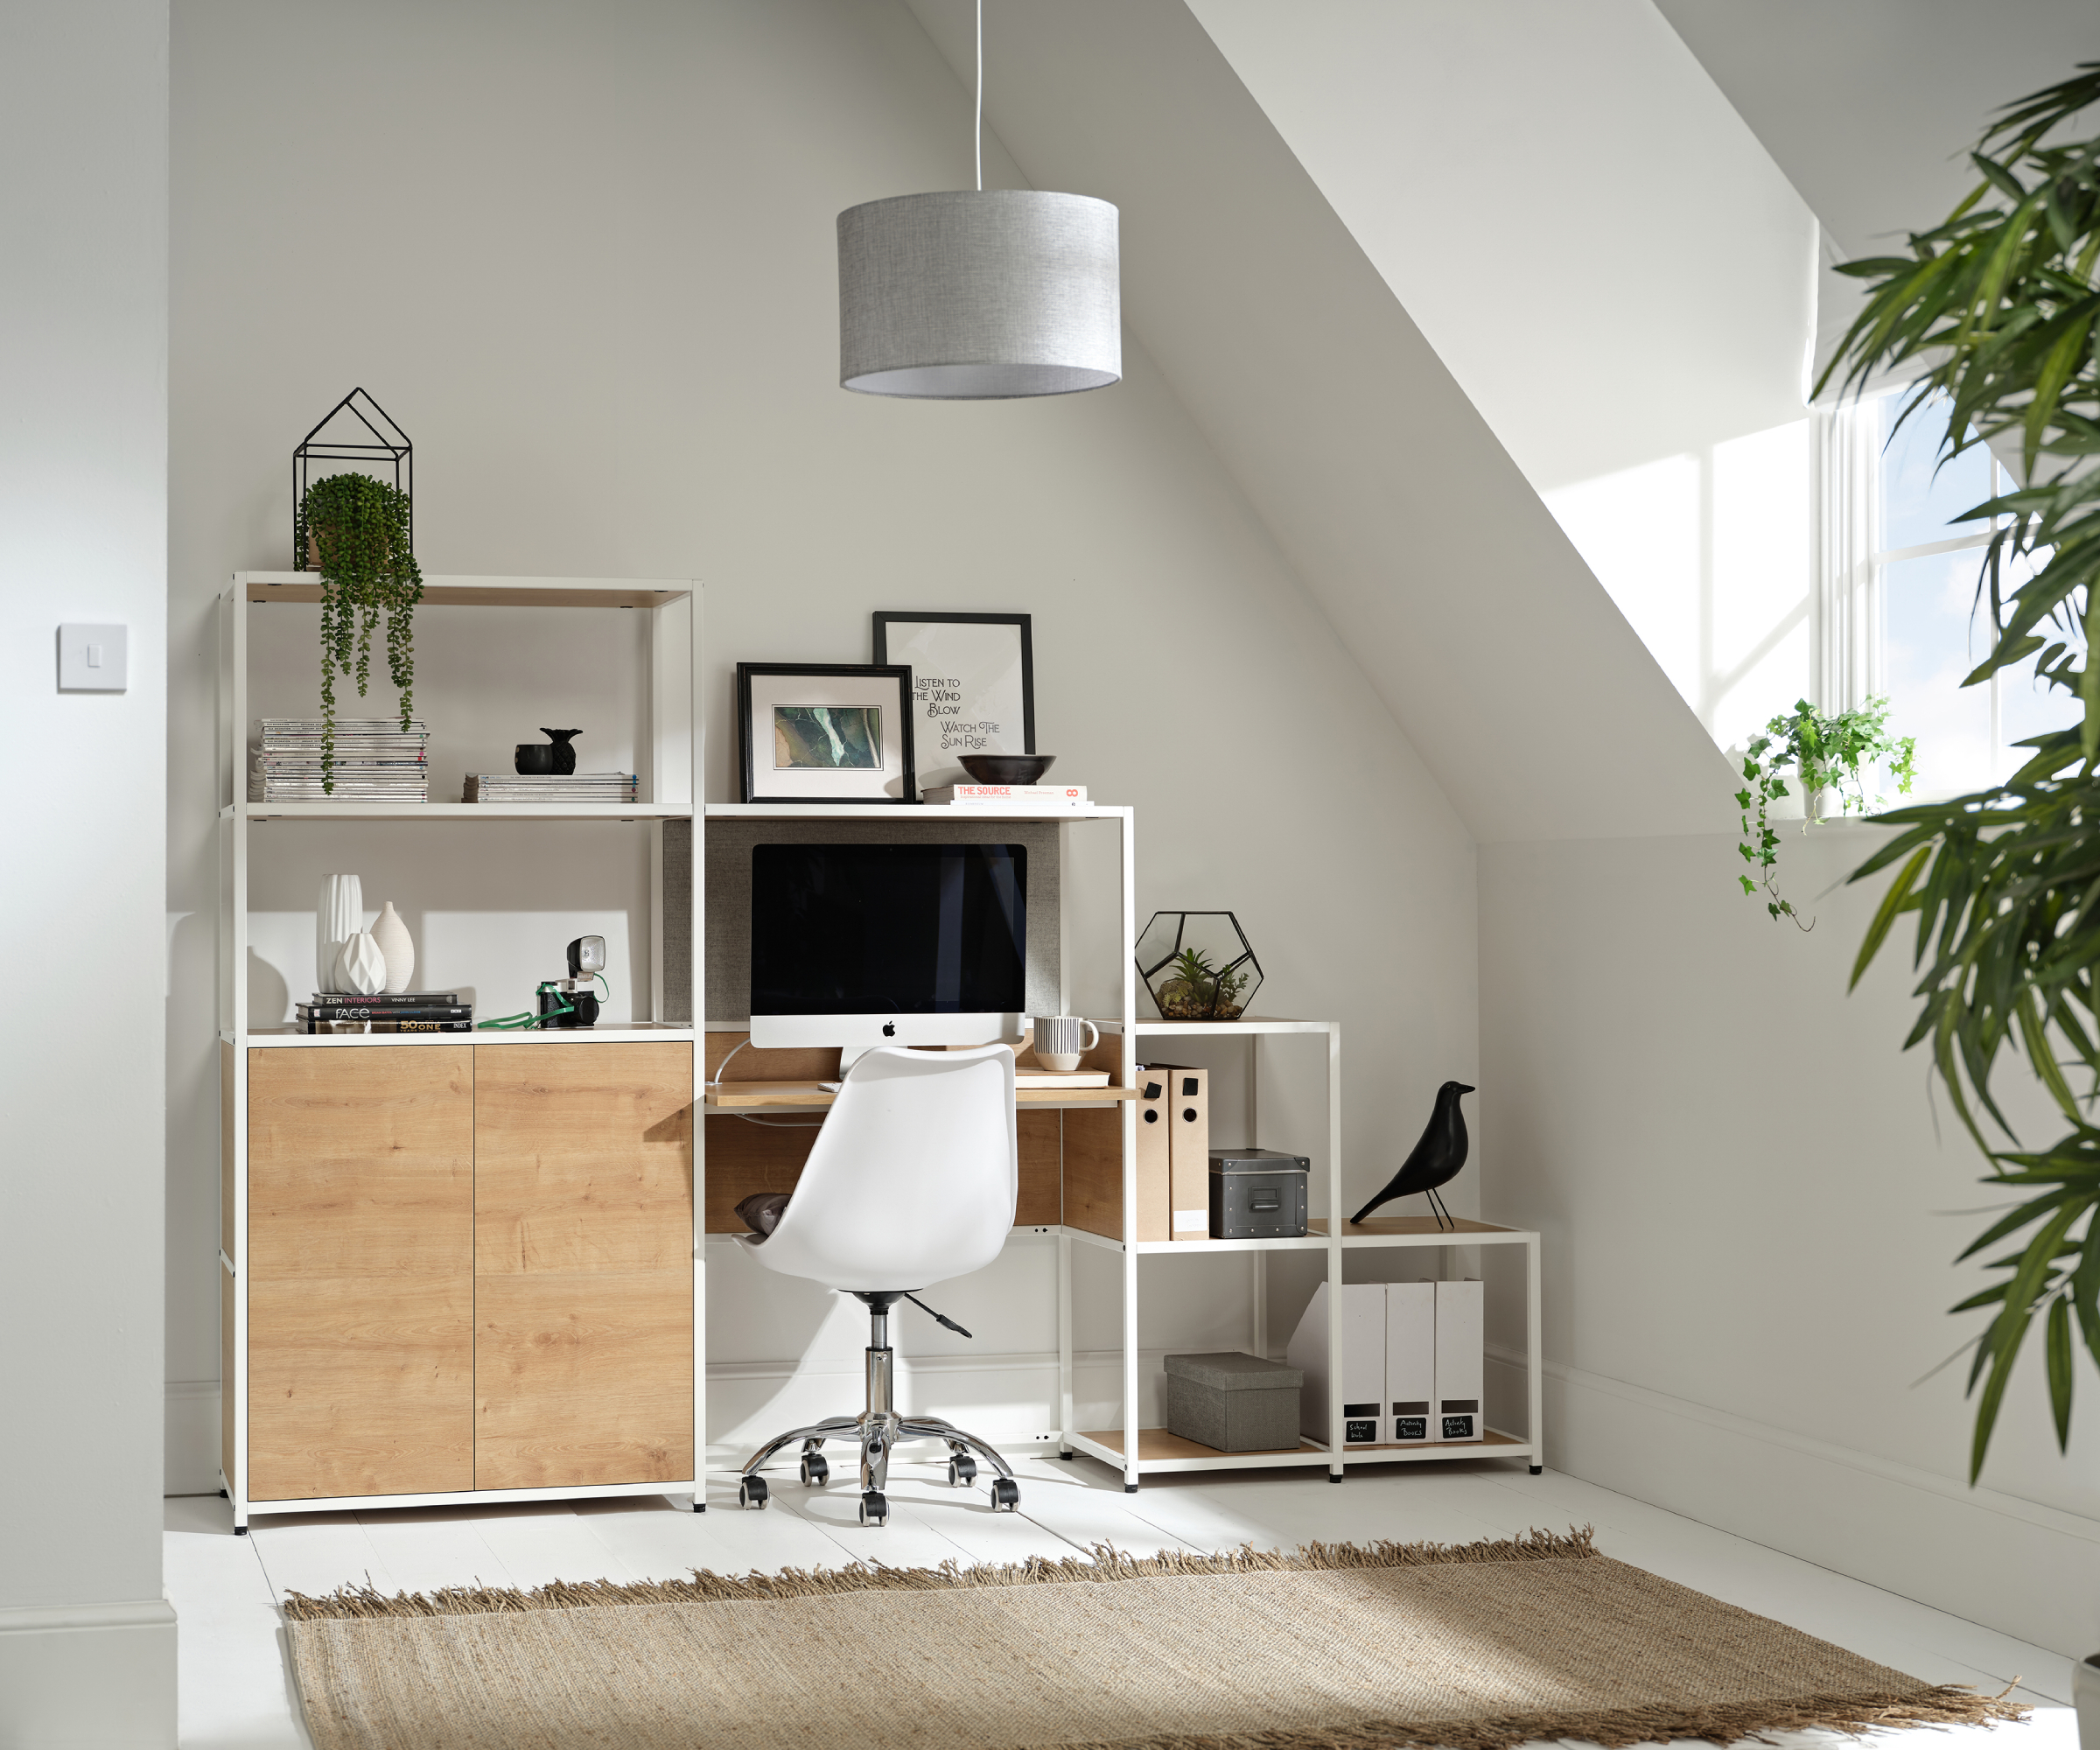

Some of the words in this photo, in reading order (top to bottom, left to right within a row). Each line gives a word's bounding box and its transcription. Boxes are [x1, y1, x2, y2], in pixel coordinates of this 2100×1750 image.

[914, 676, 944, 690] LISTEN
[947, 678, 961, 688] TO
[912, 691, 928, 701] THE
[931, 690, 961, 702] WIND
[928, 703, 961, 718] BLOW
[940, 721, 976, 733] WATCH
[978, 722, 1000, 734] THE
[941, 734, 962, 749] SUN
[964, 735, 987, 749] RISE
[957, 786, 976, 795] THE
[976, 787, 1012, 795] SOURCE
[400, 1020, 418, 1029] 50
